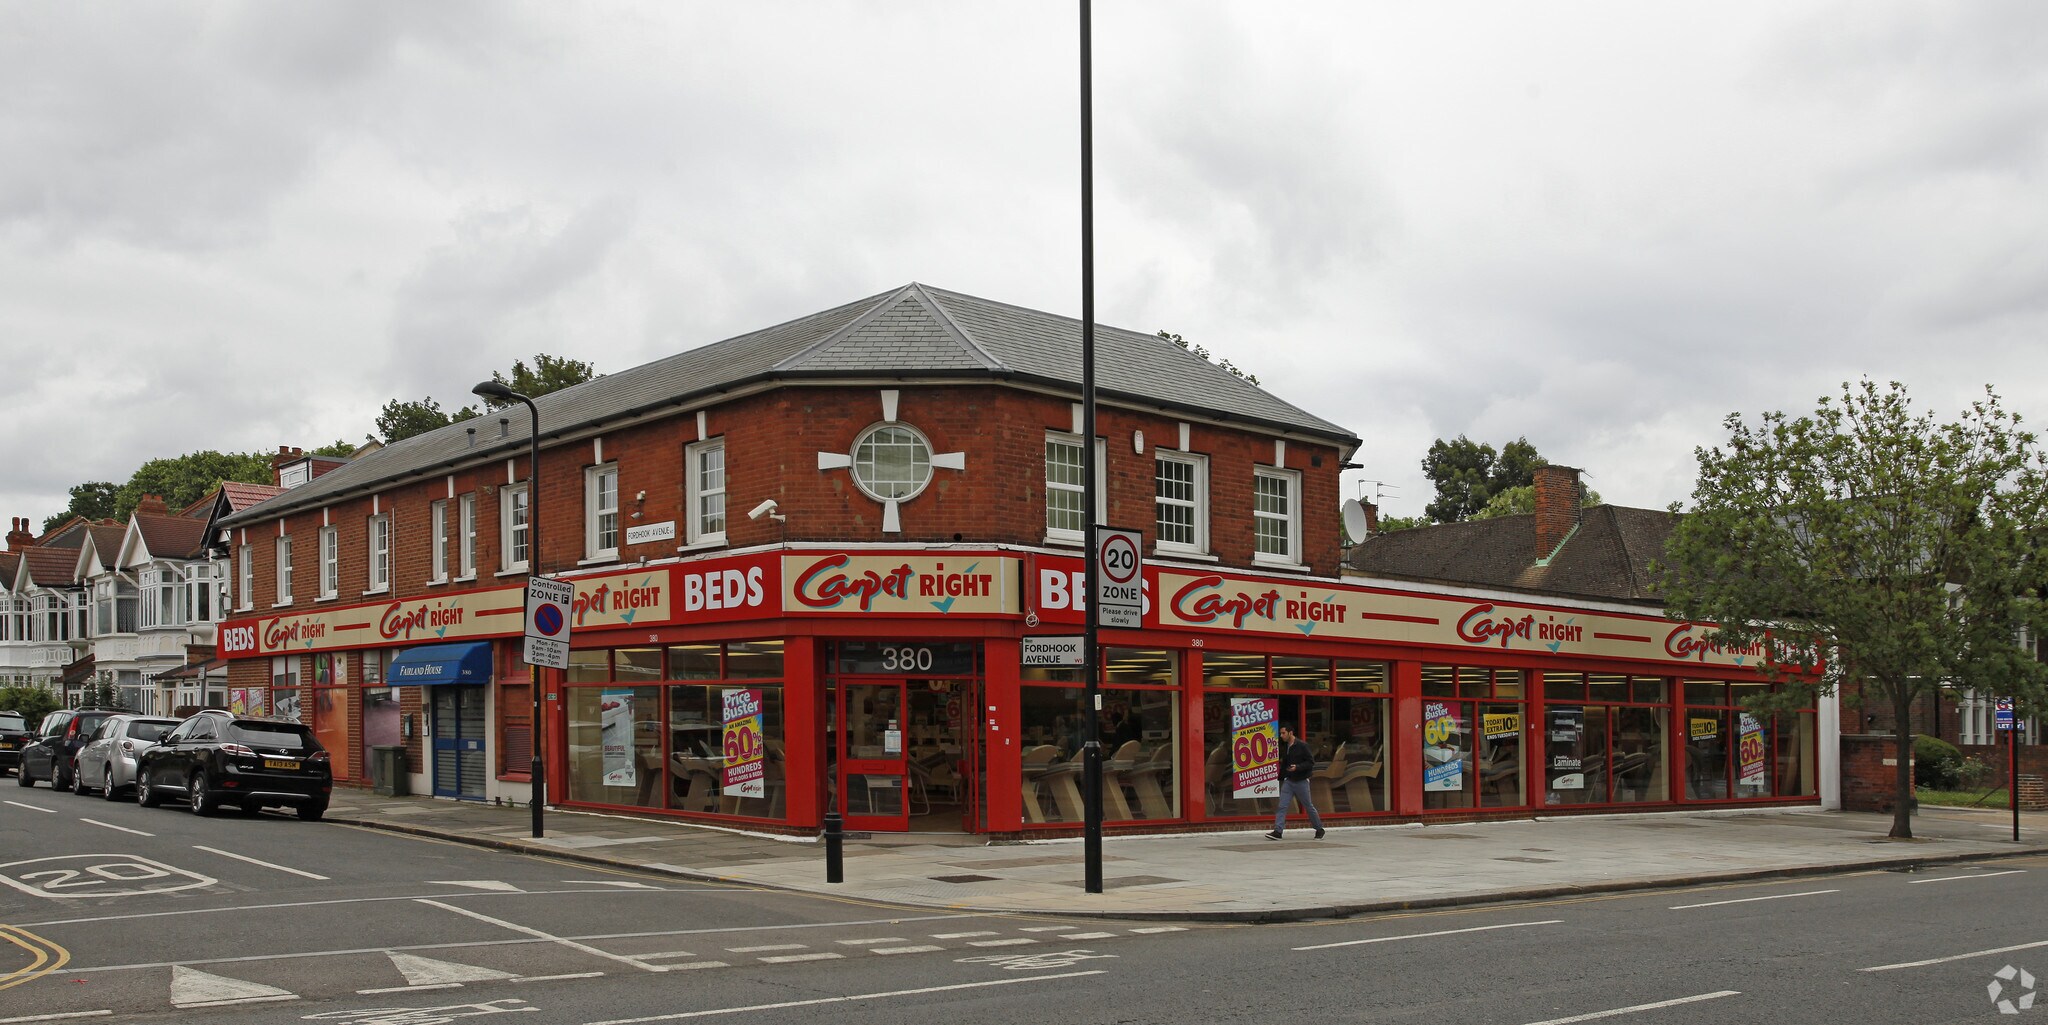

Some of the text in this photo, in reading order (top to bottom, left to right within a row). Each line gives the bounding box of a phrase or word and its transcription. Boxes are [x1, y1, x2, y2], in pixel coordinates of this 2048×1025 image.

[628, 529, 651, 539] FORDHOOK
[652, 526, 670, 536] AVENUE
[1107, 548, 1134, 570] 20
[531, 578, 571, 593] Controlled
[684, 566, 764, 612] BEDS
[793, 553, 915, 611] Carpet
[530, 588, 559, 602] ZONE
[1103, 585, 1138, 600] ZONE
[1170, 575, 1281, 629] Carpet
[1102, 607, 1138, 616] Please drive
[379, 601, 429, 640] Carpet
[1110, 616, 1130, 625] slowly
[1456, 603, 1536, 648] Carpet
[223, 625, 255, 652] BEDS
[264, 616, 300, 650] Carpet
[648, 634, 659, 643] 380
[1024, 644, 1077, 653] FORDHOOK
[1191, 638, 1204, 647] 380
[882, 647, 933, 671] 380
[1024, 655, 1061, 663] AVENUE
[424, 664, 443, 675] HOUSE
[724, 691, 751, 707] Price
[723, 699, 759, 721] Buster
[1234, 700, 1265, 716] Price
[1425, 707, 1448, 720] Buster
[1426, 703, 1443, 713] Price
[1232, 708, 1274, 729] Buster
[1485, 718, 1502, 726] TODAY
[727, 761, 762, 777] HUNDREDS
[1238, 763, 1278, 781] HUNDREDS
[19, 863, 170, 889] 20
